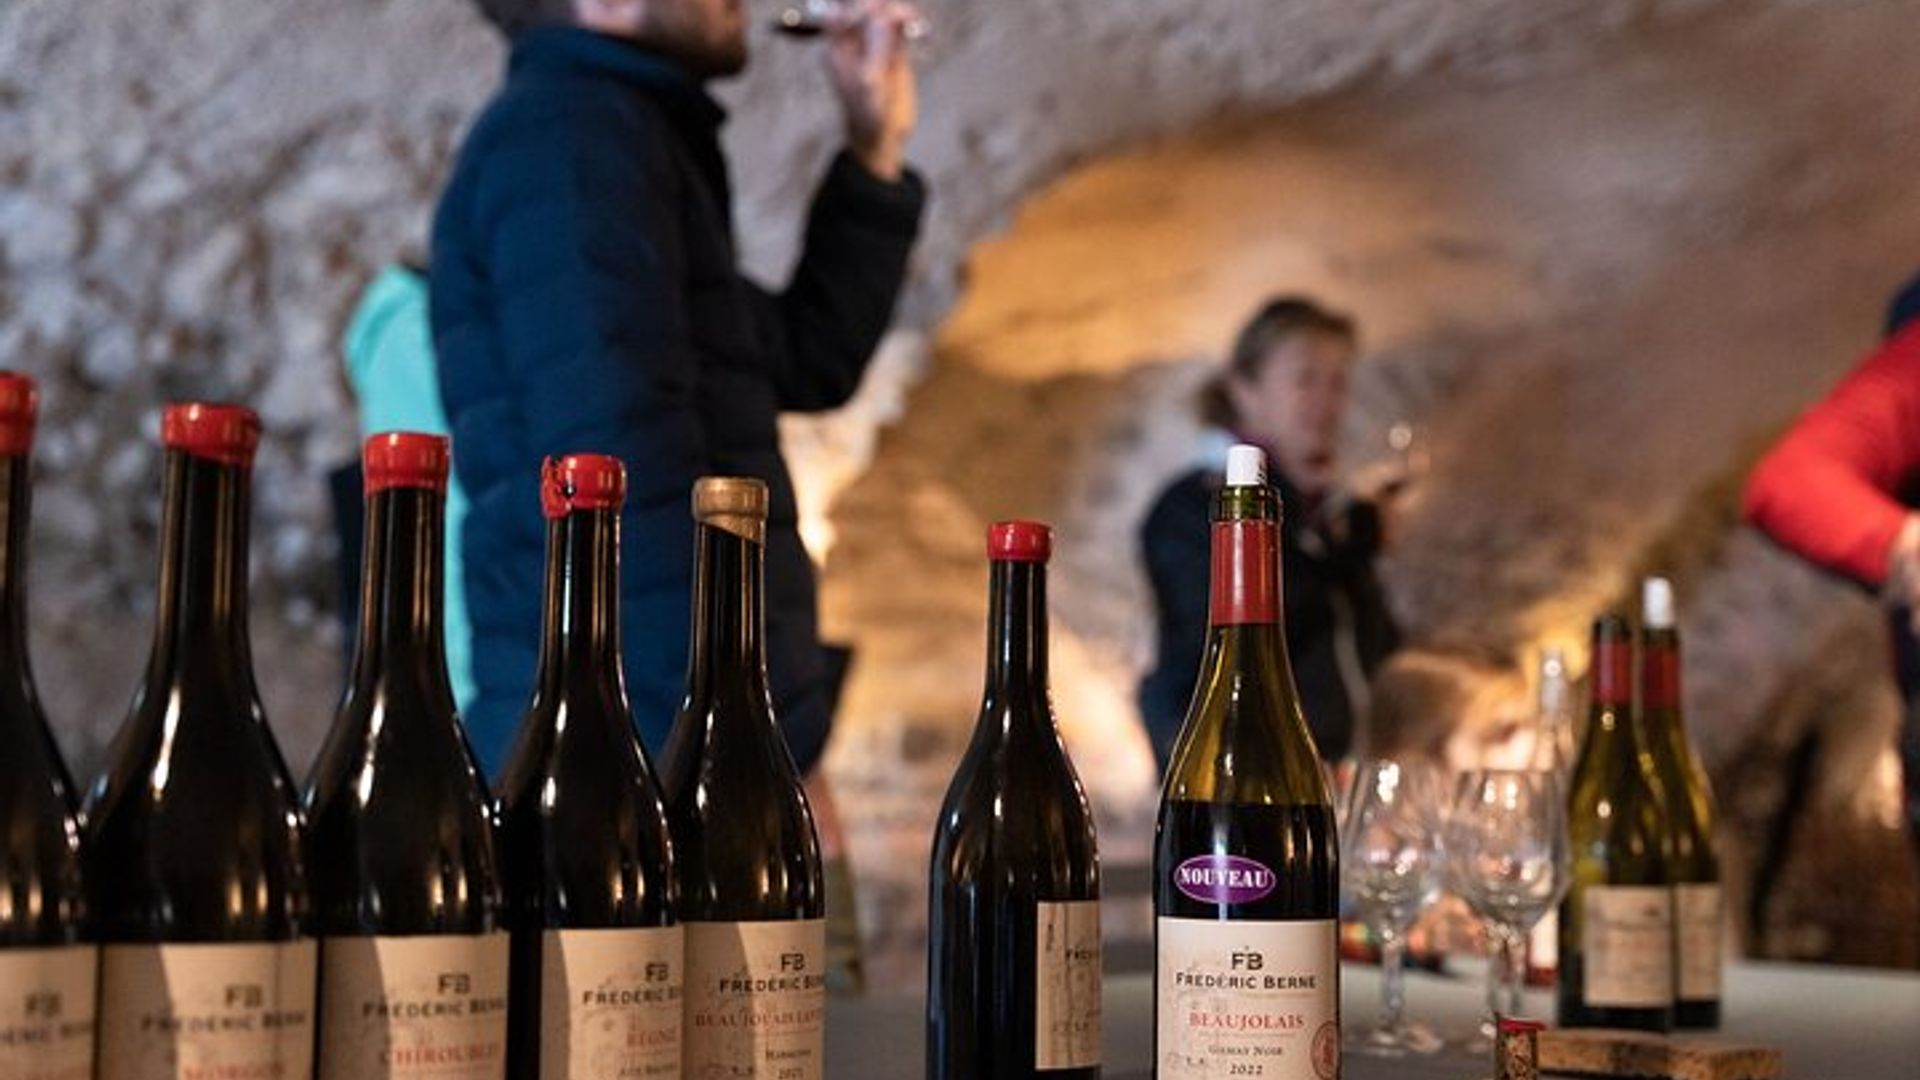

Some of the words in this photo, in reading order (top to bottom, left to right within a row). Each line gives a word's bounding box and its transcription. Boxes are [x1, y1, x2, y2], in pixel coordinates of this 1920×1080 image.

[1181, 867, 1268, 888] NOUVEAU
[1231, 952, 1264, 971] FB
[1263, 974, 1317, 989] BERNE
[1189, 1012, 1304, 1030] BEAUJOLAIS
